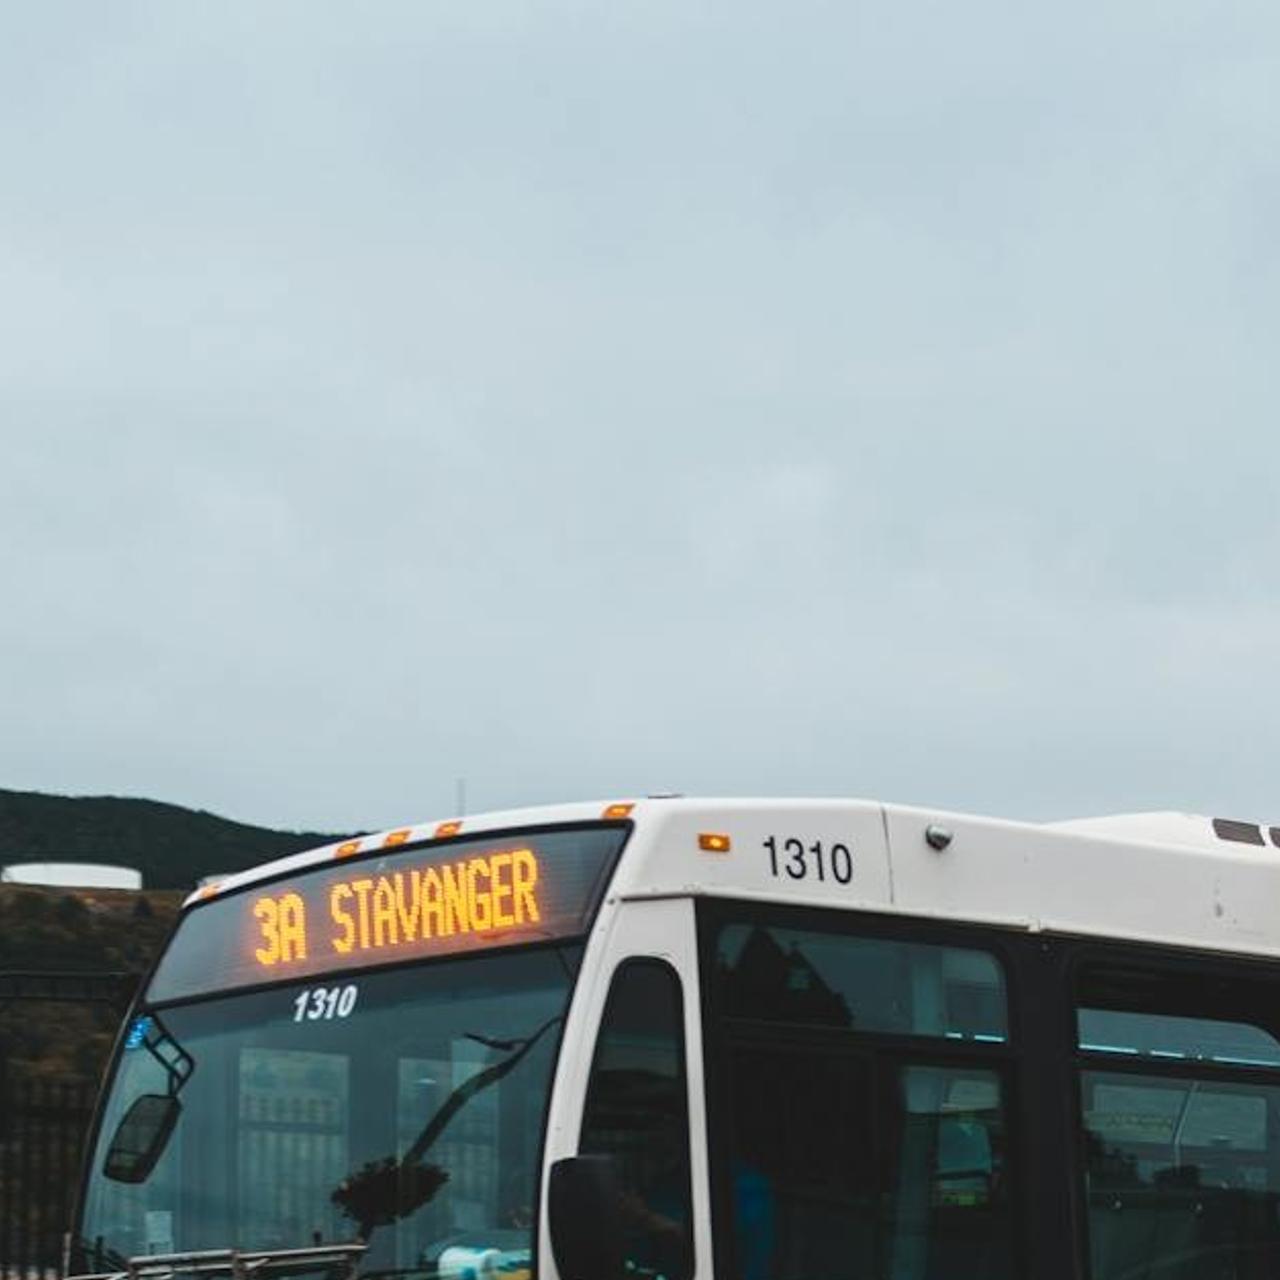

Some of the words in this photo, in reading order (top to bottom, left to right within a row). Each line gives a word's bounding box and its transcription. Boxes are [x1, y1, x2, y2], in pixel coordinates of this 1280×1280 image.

[763, 836, 853, 885] 1310
[253, 892, 308, 965] 3A
[330, 848, 540, 953] STAVANGER
[293, 985, 358, 1022] 1310
